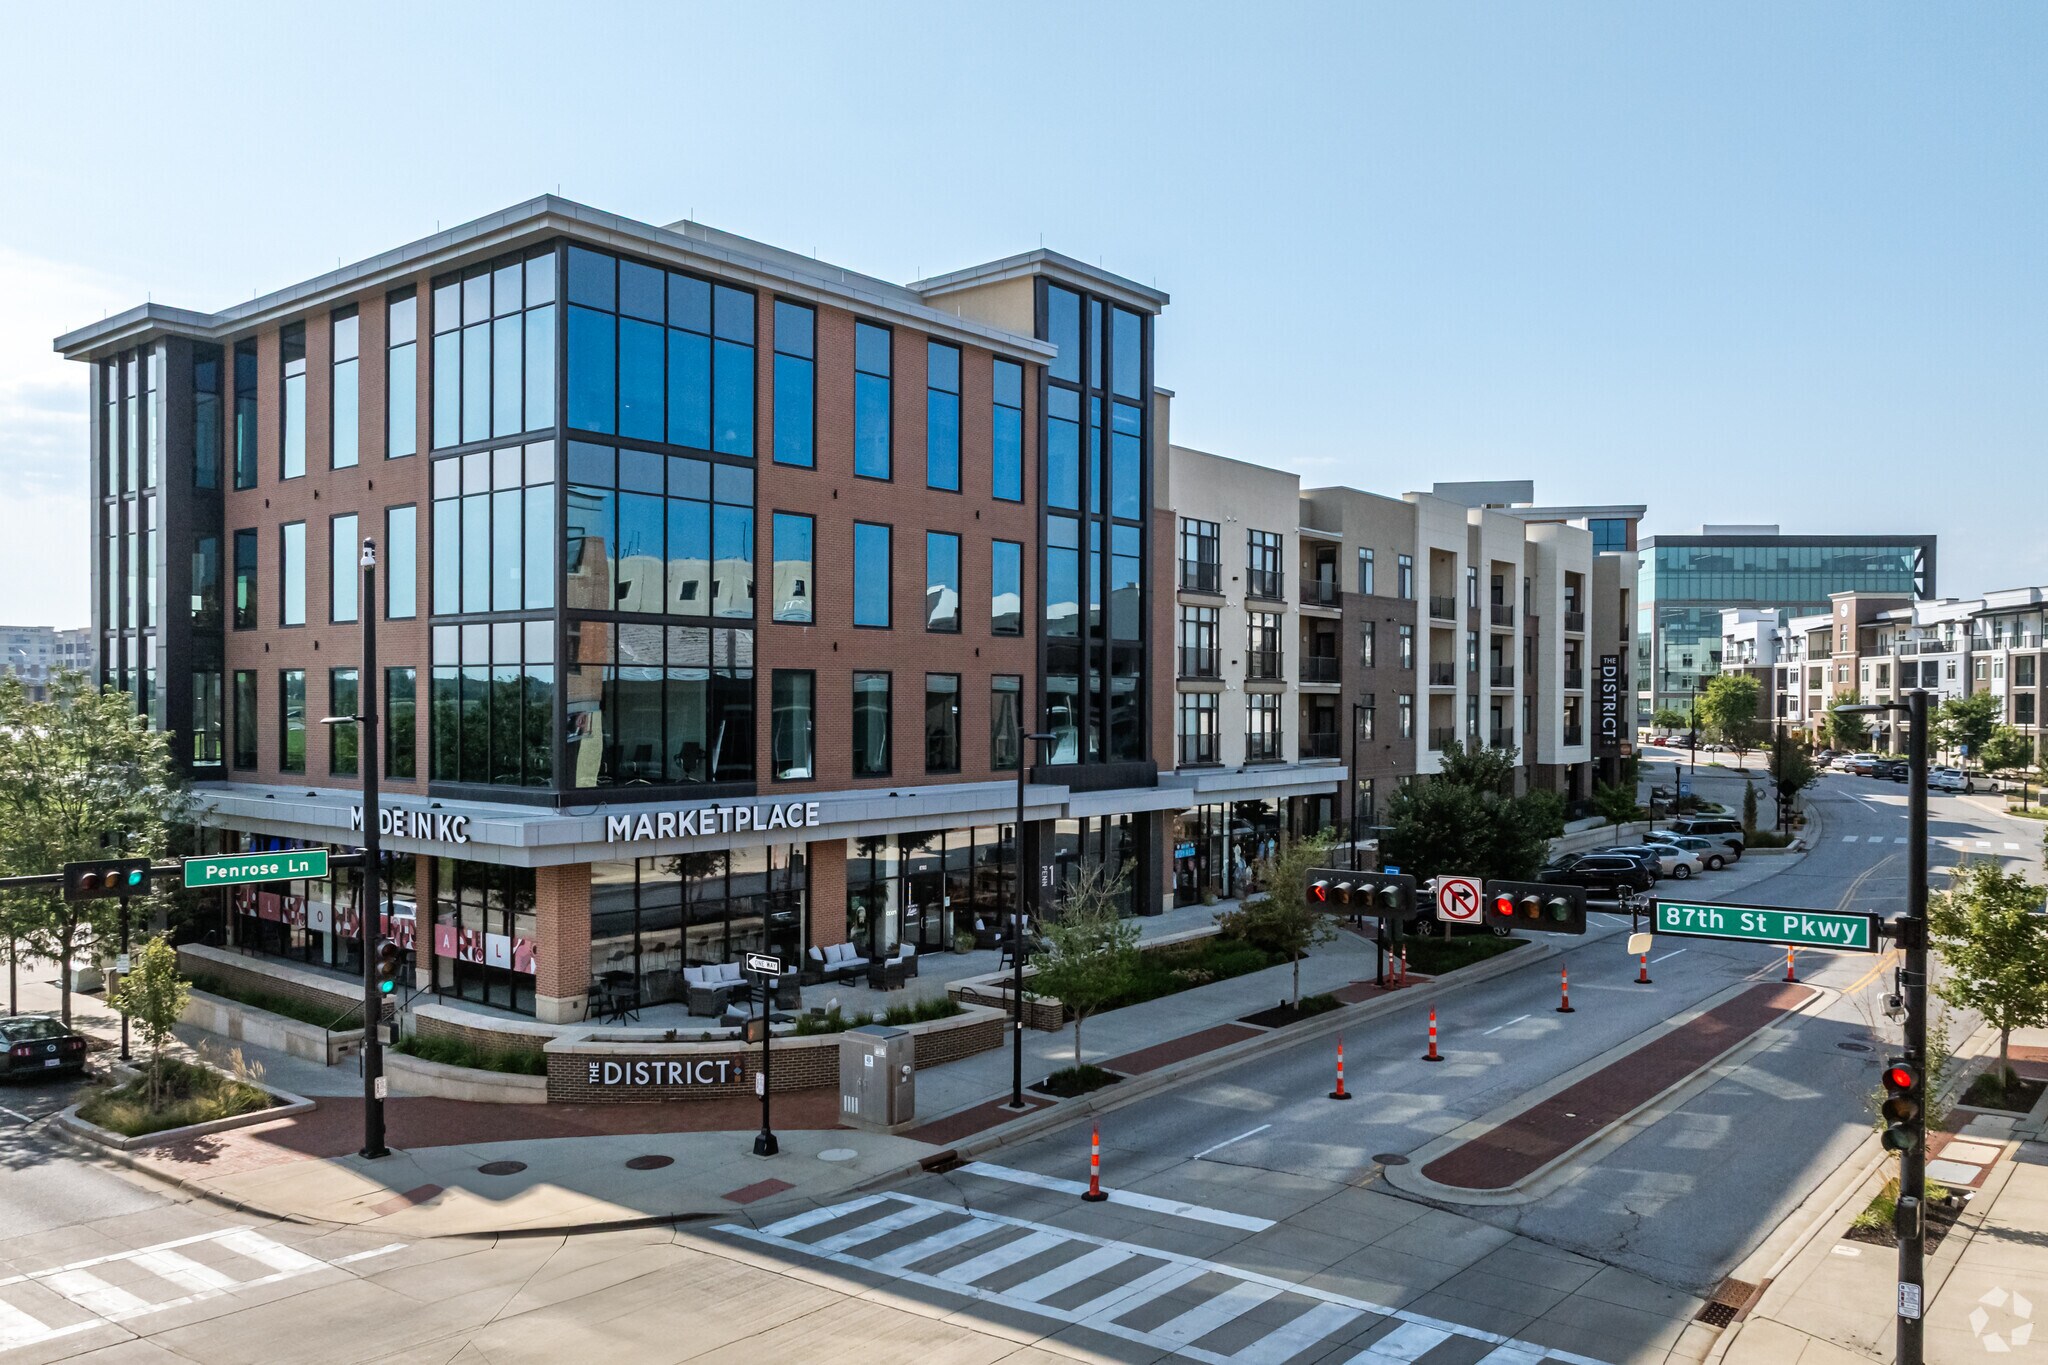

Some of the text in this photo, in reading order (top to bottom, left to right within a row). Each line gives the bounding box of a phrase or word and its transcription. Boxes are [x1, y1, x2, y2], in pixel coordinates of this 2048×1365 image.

[1602, 666, 1616, 737] DISTRICT
[350, 805, 468, 844] MDE IN KC
[606, 801, 820, 843] MARKETPLACE
[206, 860, 309, 880] Penrose Ln
[1049, 865, 1054, 886] 1
[1666, 907, 1858, 944] 87th St Pkwy
[589, 1061, 600, 1084] THE
[604, 1060, 730, 1085] DISTRICT
